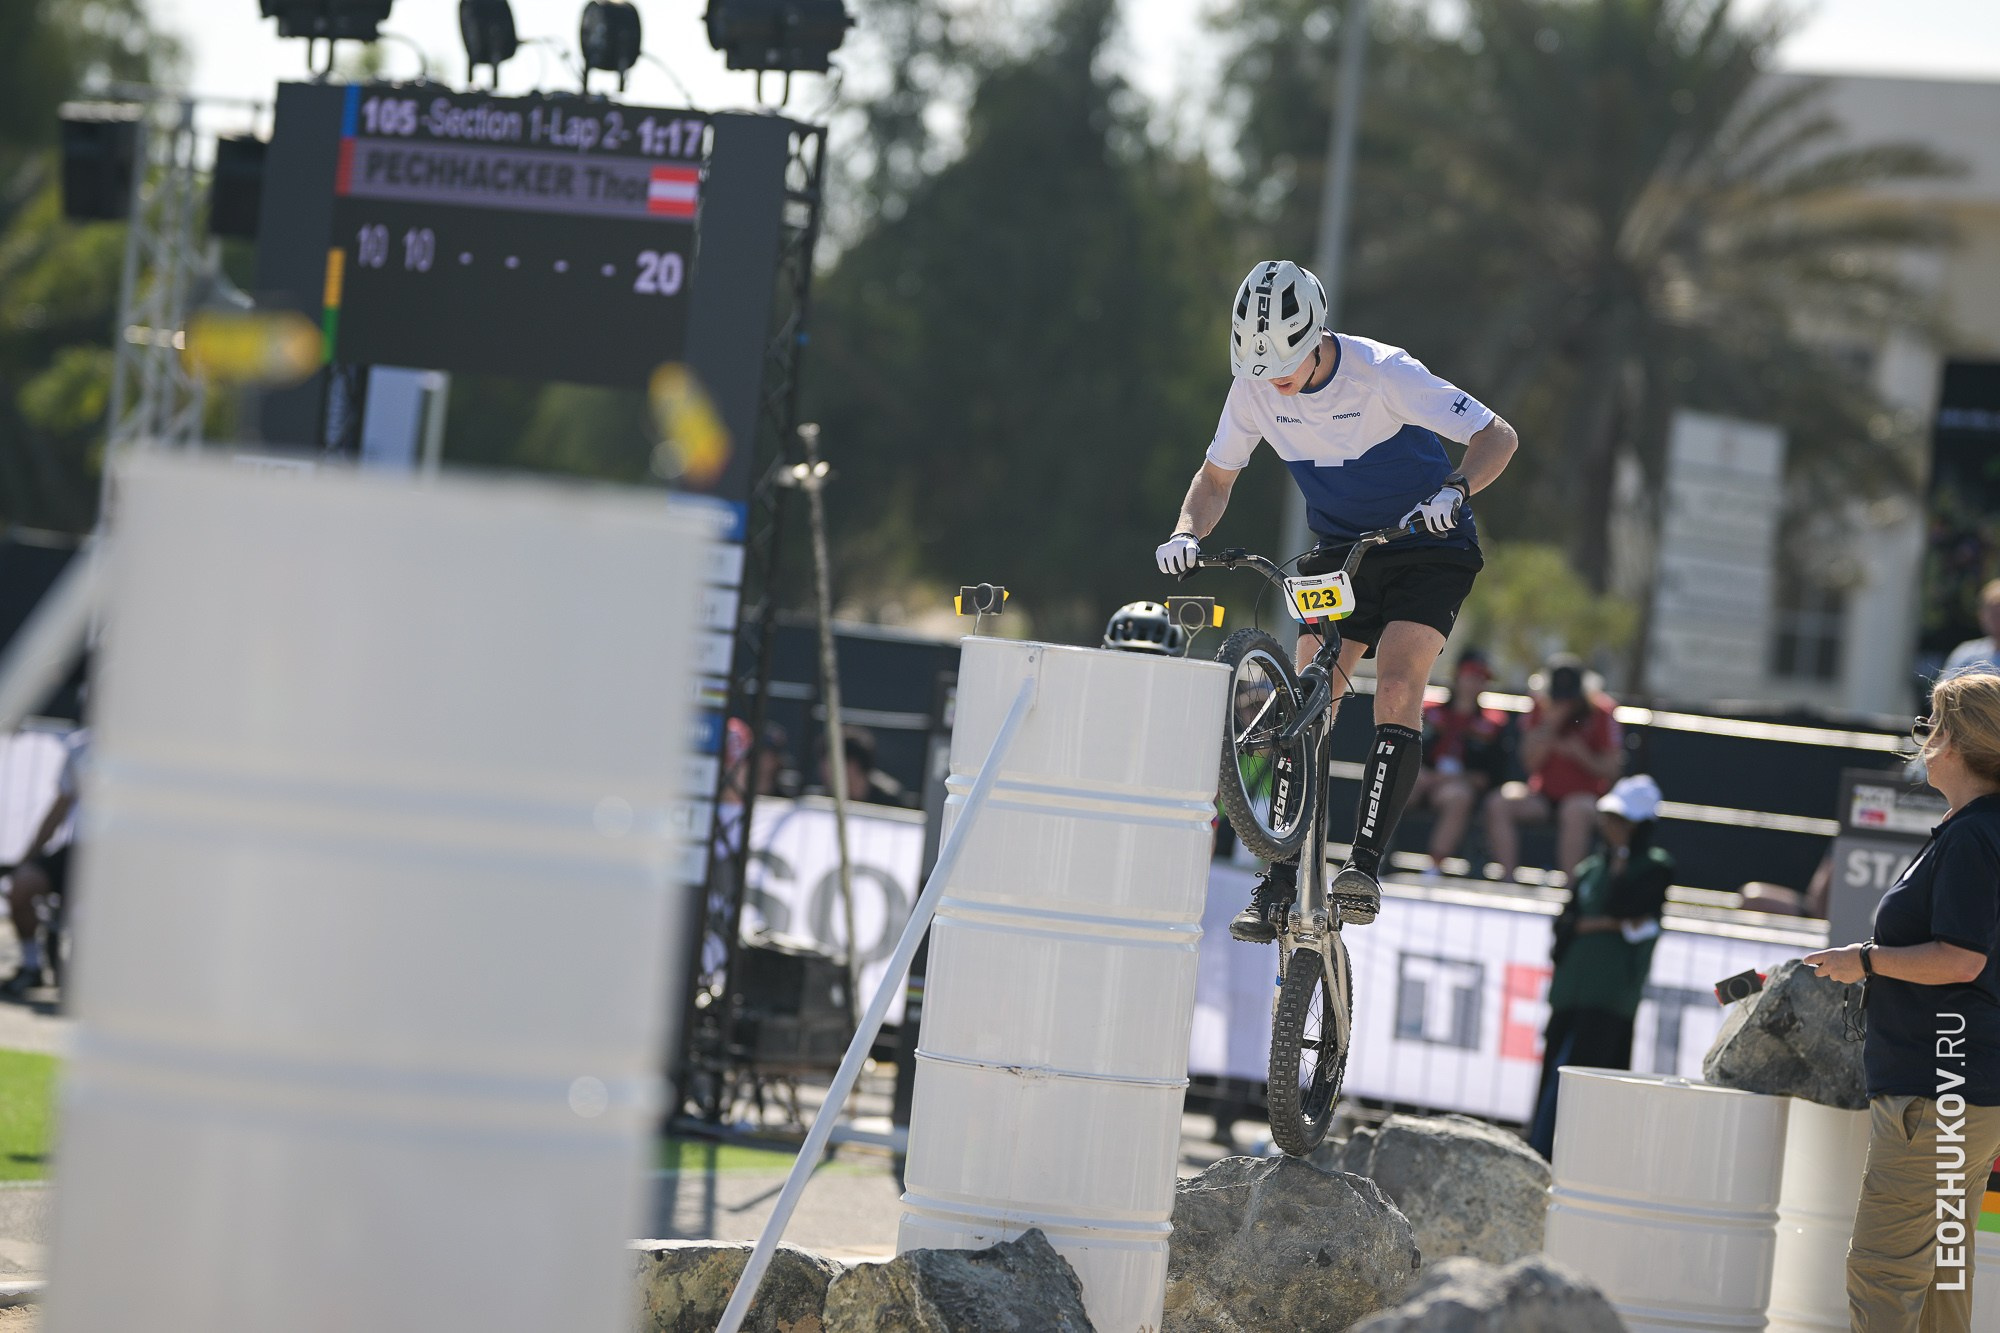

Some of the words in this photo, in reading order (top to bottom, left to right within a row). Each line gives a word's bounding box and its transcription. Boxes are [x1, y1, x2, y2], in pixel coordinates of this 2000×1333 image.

[363, 97, 418, 135] 105
[637, 116, 704, 157] 1:17
[365, 149, 575, 198] PECHHACKER
[356, 223, 389, 269] 10
[402, 227, 435, 272] 10
[633, 250, 684, 296] 20
[1333, 411, 1360, 420] moomoo
[1301, 590, 1336, 609] 123
[1361, 761, 1387, 839] hebo
